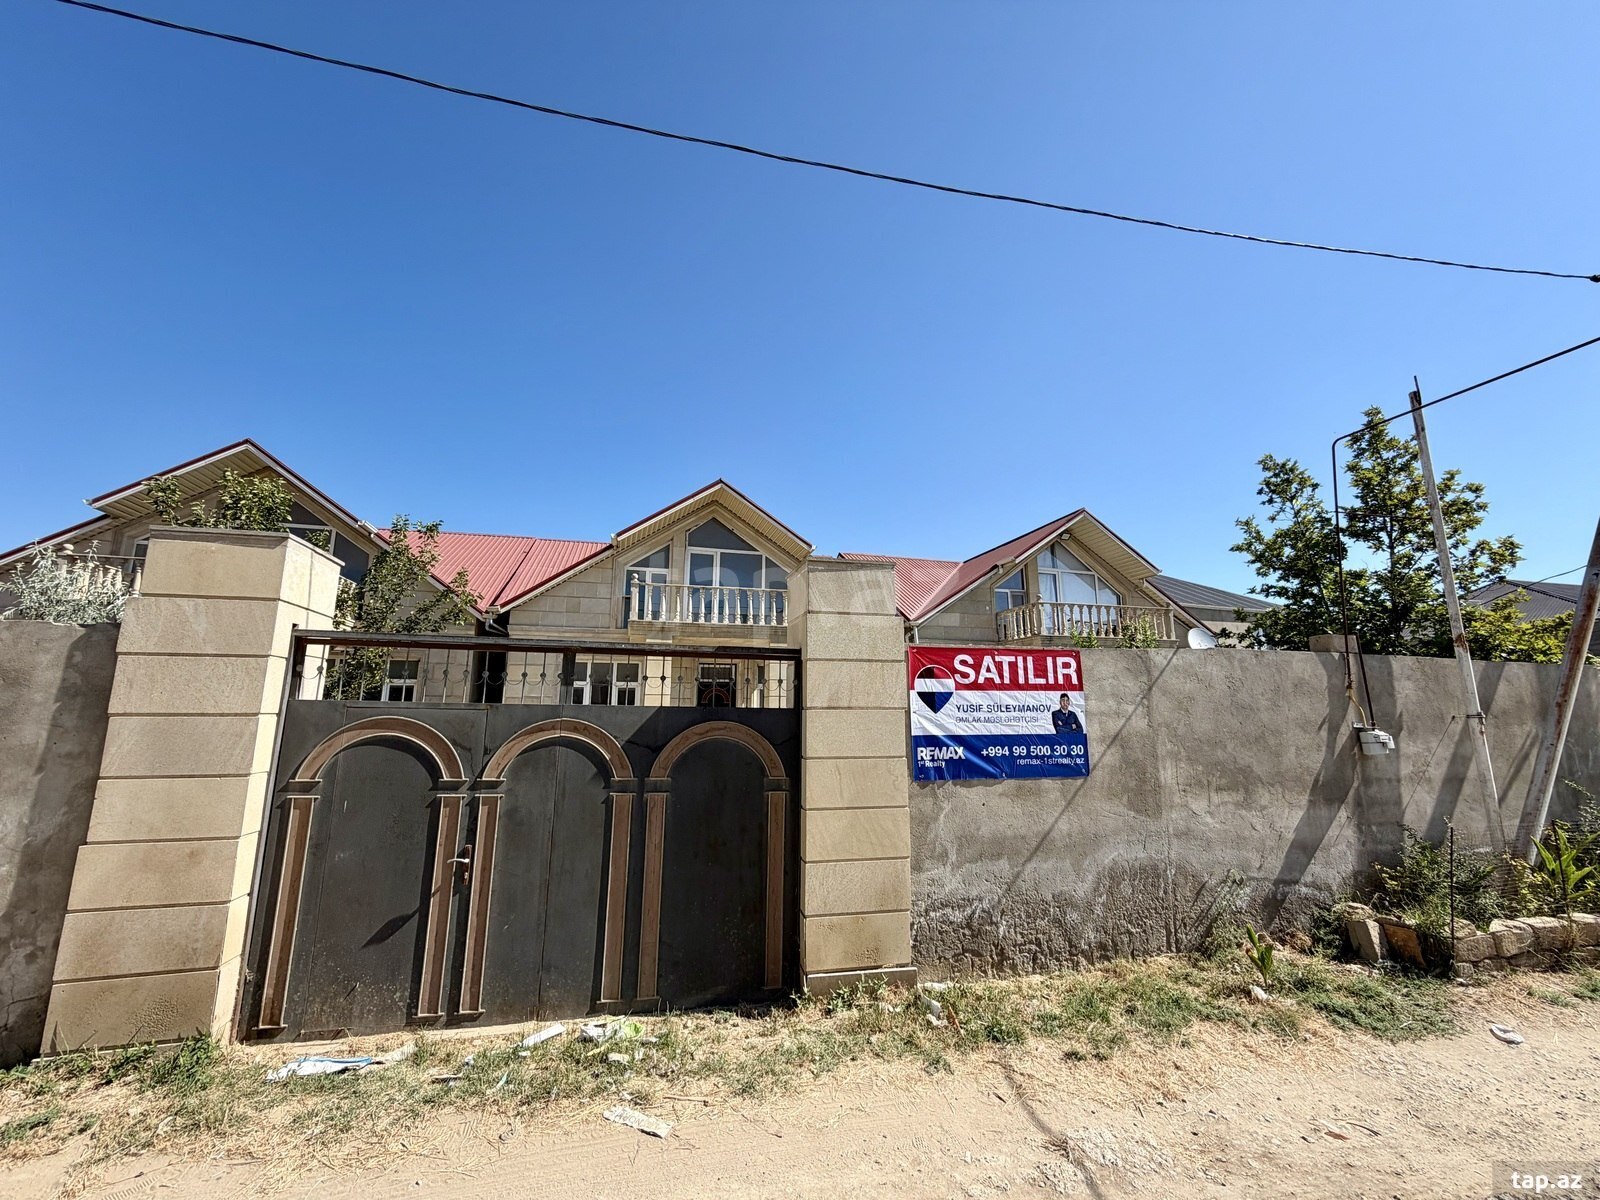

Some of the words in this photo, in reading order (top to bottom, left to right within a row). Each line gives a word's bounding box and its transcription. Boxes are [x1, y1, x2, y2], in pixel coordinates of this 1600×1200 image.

[953, 654, 1079, 685] SATILIR
[986, 702, 1052, 713] SÜLEYMANOV
[917, 746, 966, 760] REMAX
[981, 746, 1009, 757] +994
[1012, 745, 1027, 756] 99
[1030, 745, 1051, 756] 500
[1053, 745, 1068, 756] 30
[1070, 744, 1084, 755] 30
[925, 760, 946, 768] Realty
[1016, 757, 1085, 766] remax-1strealty.az
